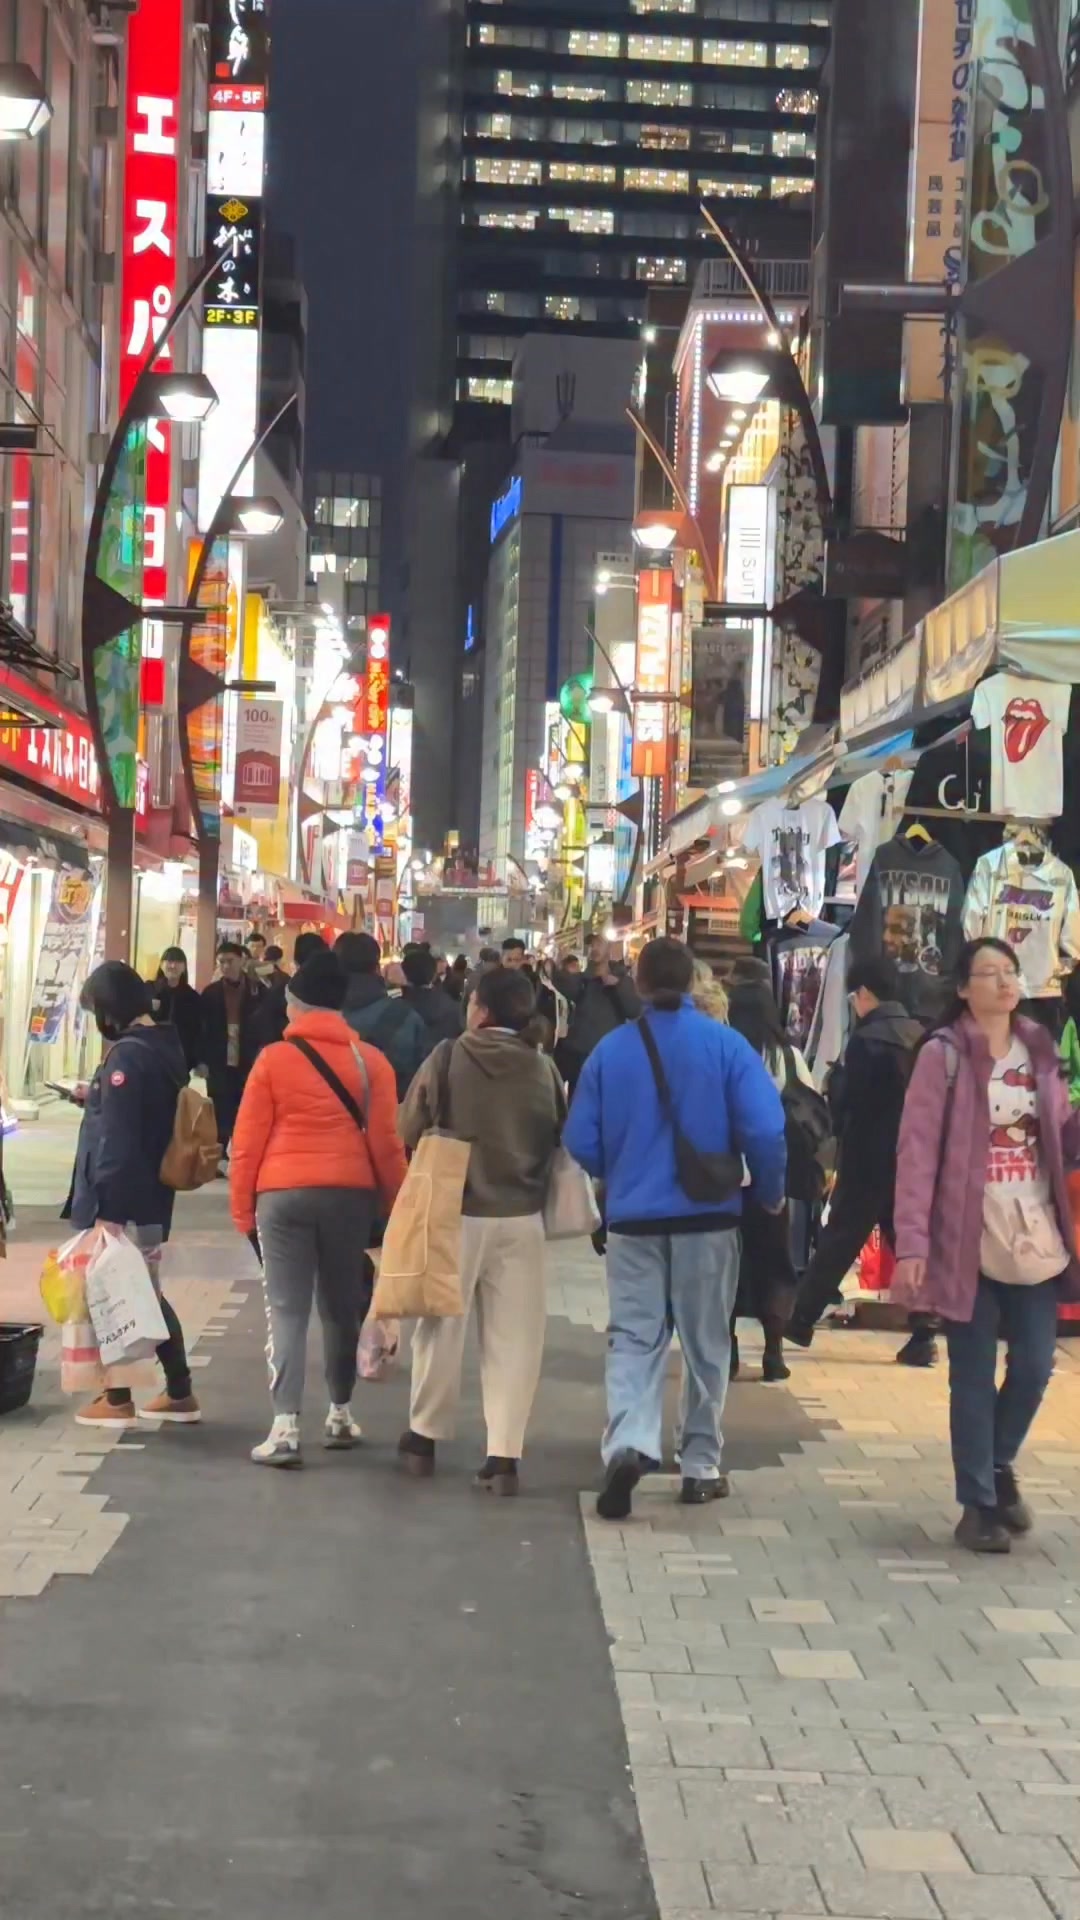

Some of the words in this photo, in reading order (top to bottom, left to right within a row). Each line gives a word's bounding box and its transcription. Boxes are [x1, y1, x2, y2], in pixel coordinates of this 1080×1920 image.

[127, 95, 175, 659] エスパ日
[741, 557, 757, 600] SUIT
[880, 870, 950, 915] TYSON
